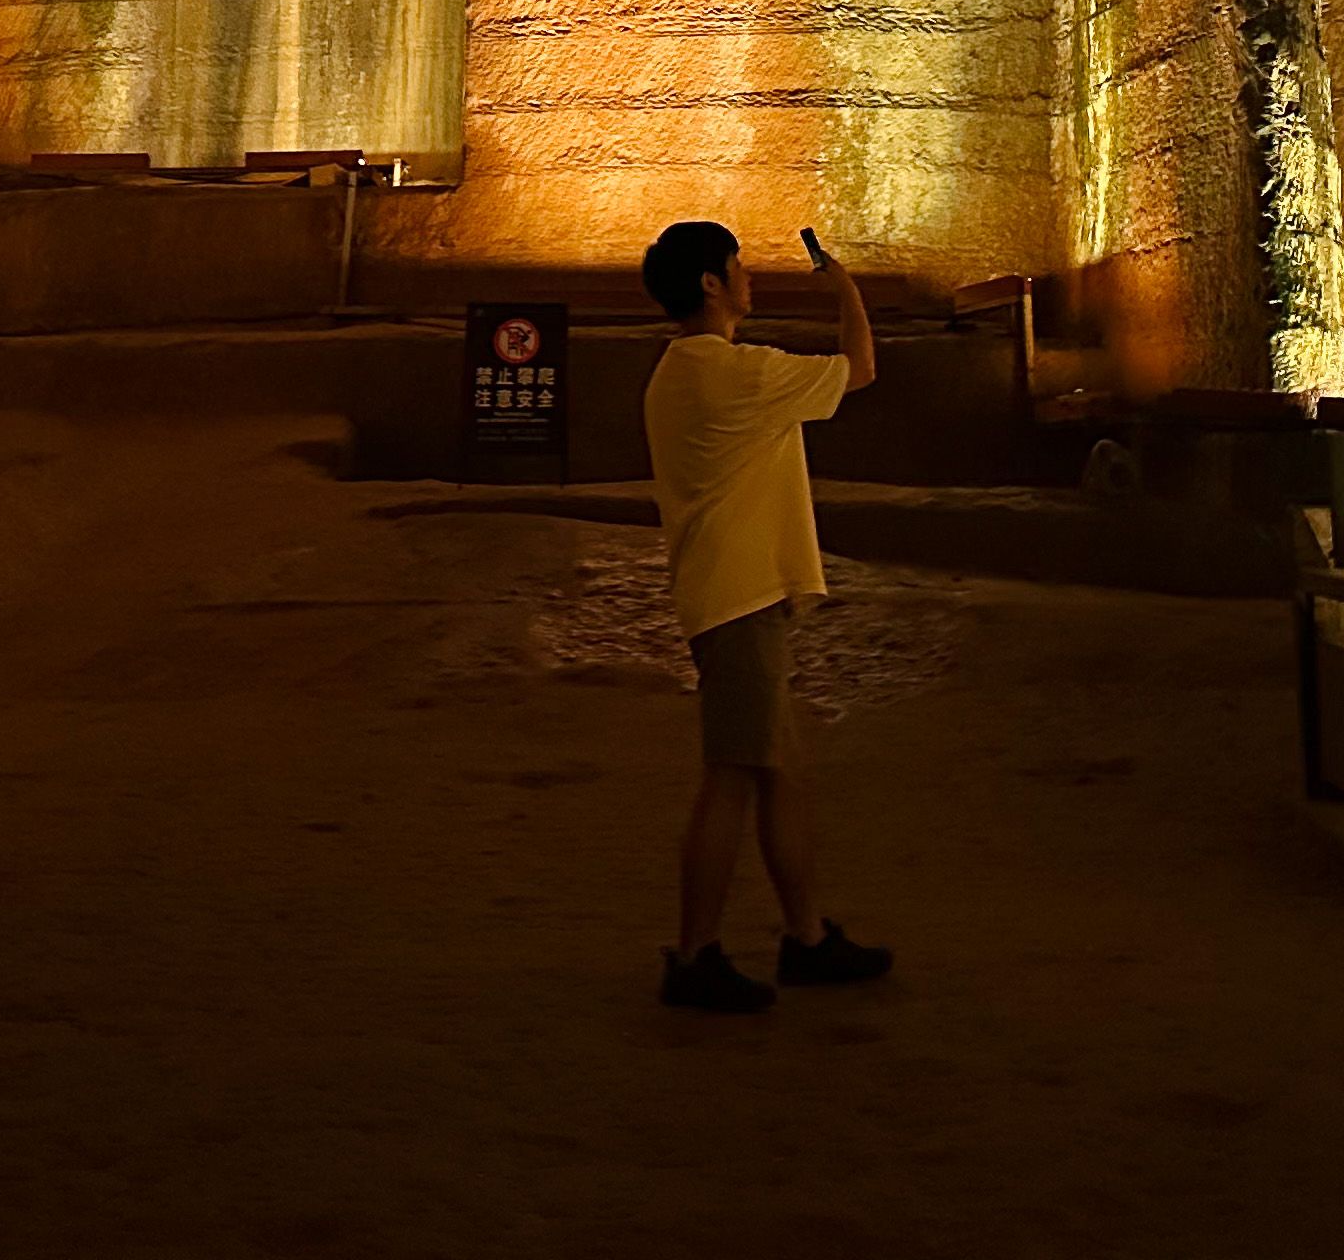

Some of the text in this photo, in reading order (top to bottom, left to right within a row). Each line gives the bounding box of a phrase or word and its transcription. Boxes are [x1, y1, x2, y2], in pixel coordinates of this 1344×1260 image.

[476, 367, 555, 385] 禁止攀爬
[475, 389, 554, 408] 注意安全
